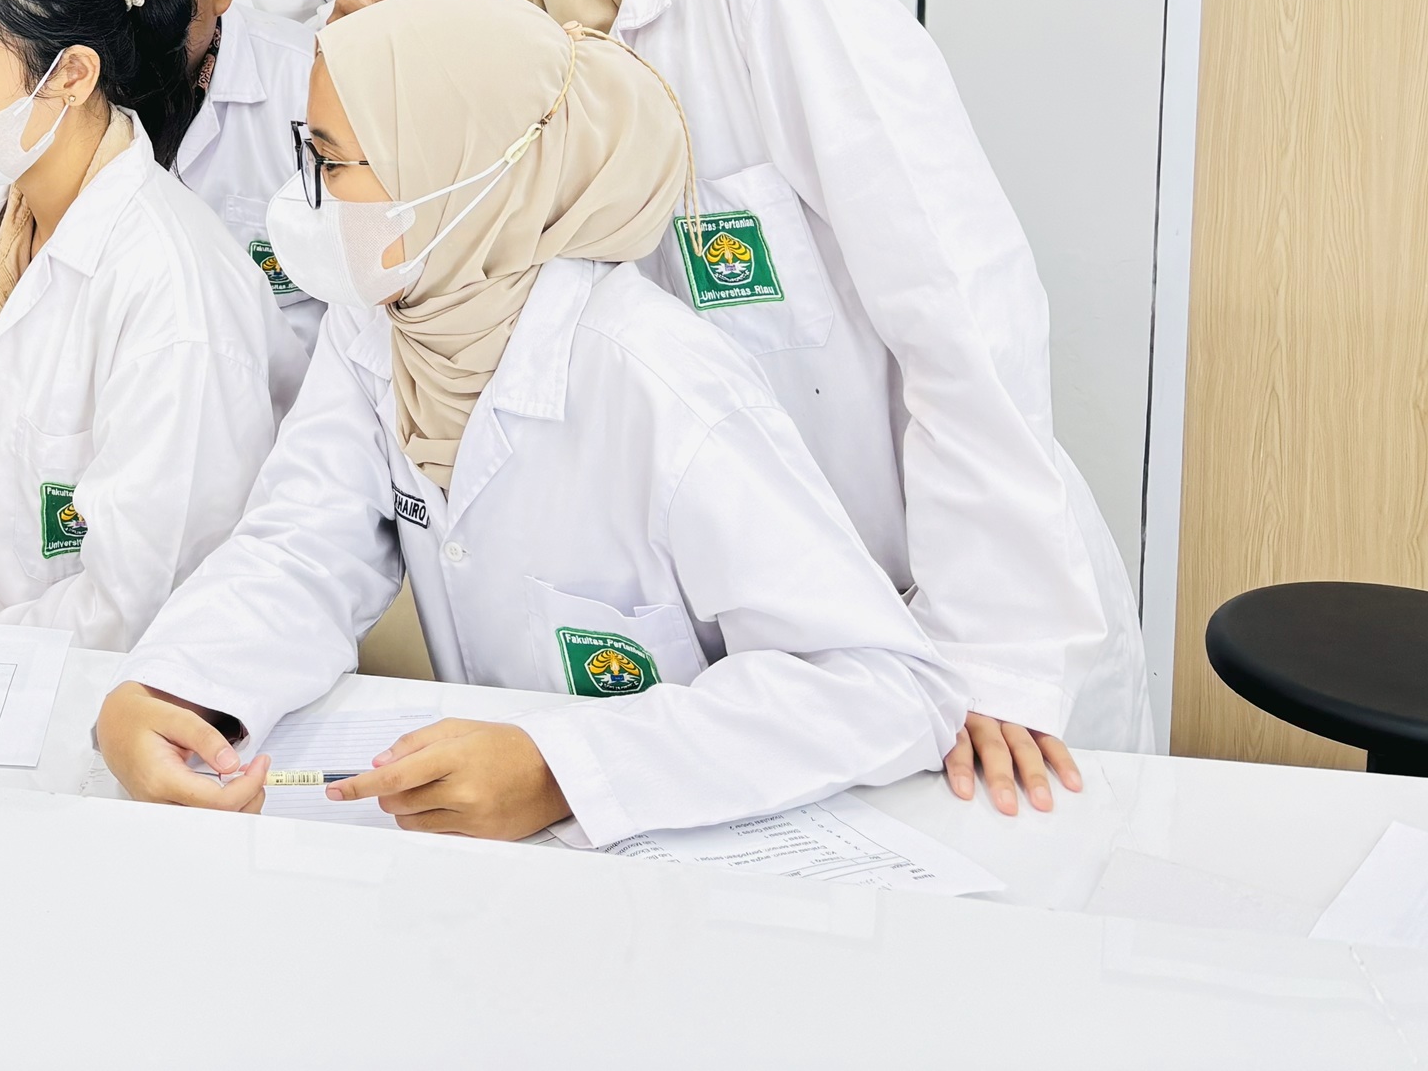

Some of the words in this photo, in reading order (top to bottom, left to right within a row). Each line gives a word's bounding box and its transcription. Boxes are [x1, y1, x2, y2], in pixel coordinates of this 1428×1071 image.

[718, 218, 755, 230] Pertanian
[701, 287, 752, 300] Universitas
[754, 285, 774, 295] Riau
[46, 487, 74, 497] Fakulta
[48, 539, 83, 550] Universit
[565, 634, 604, 646] Fakultas
